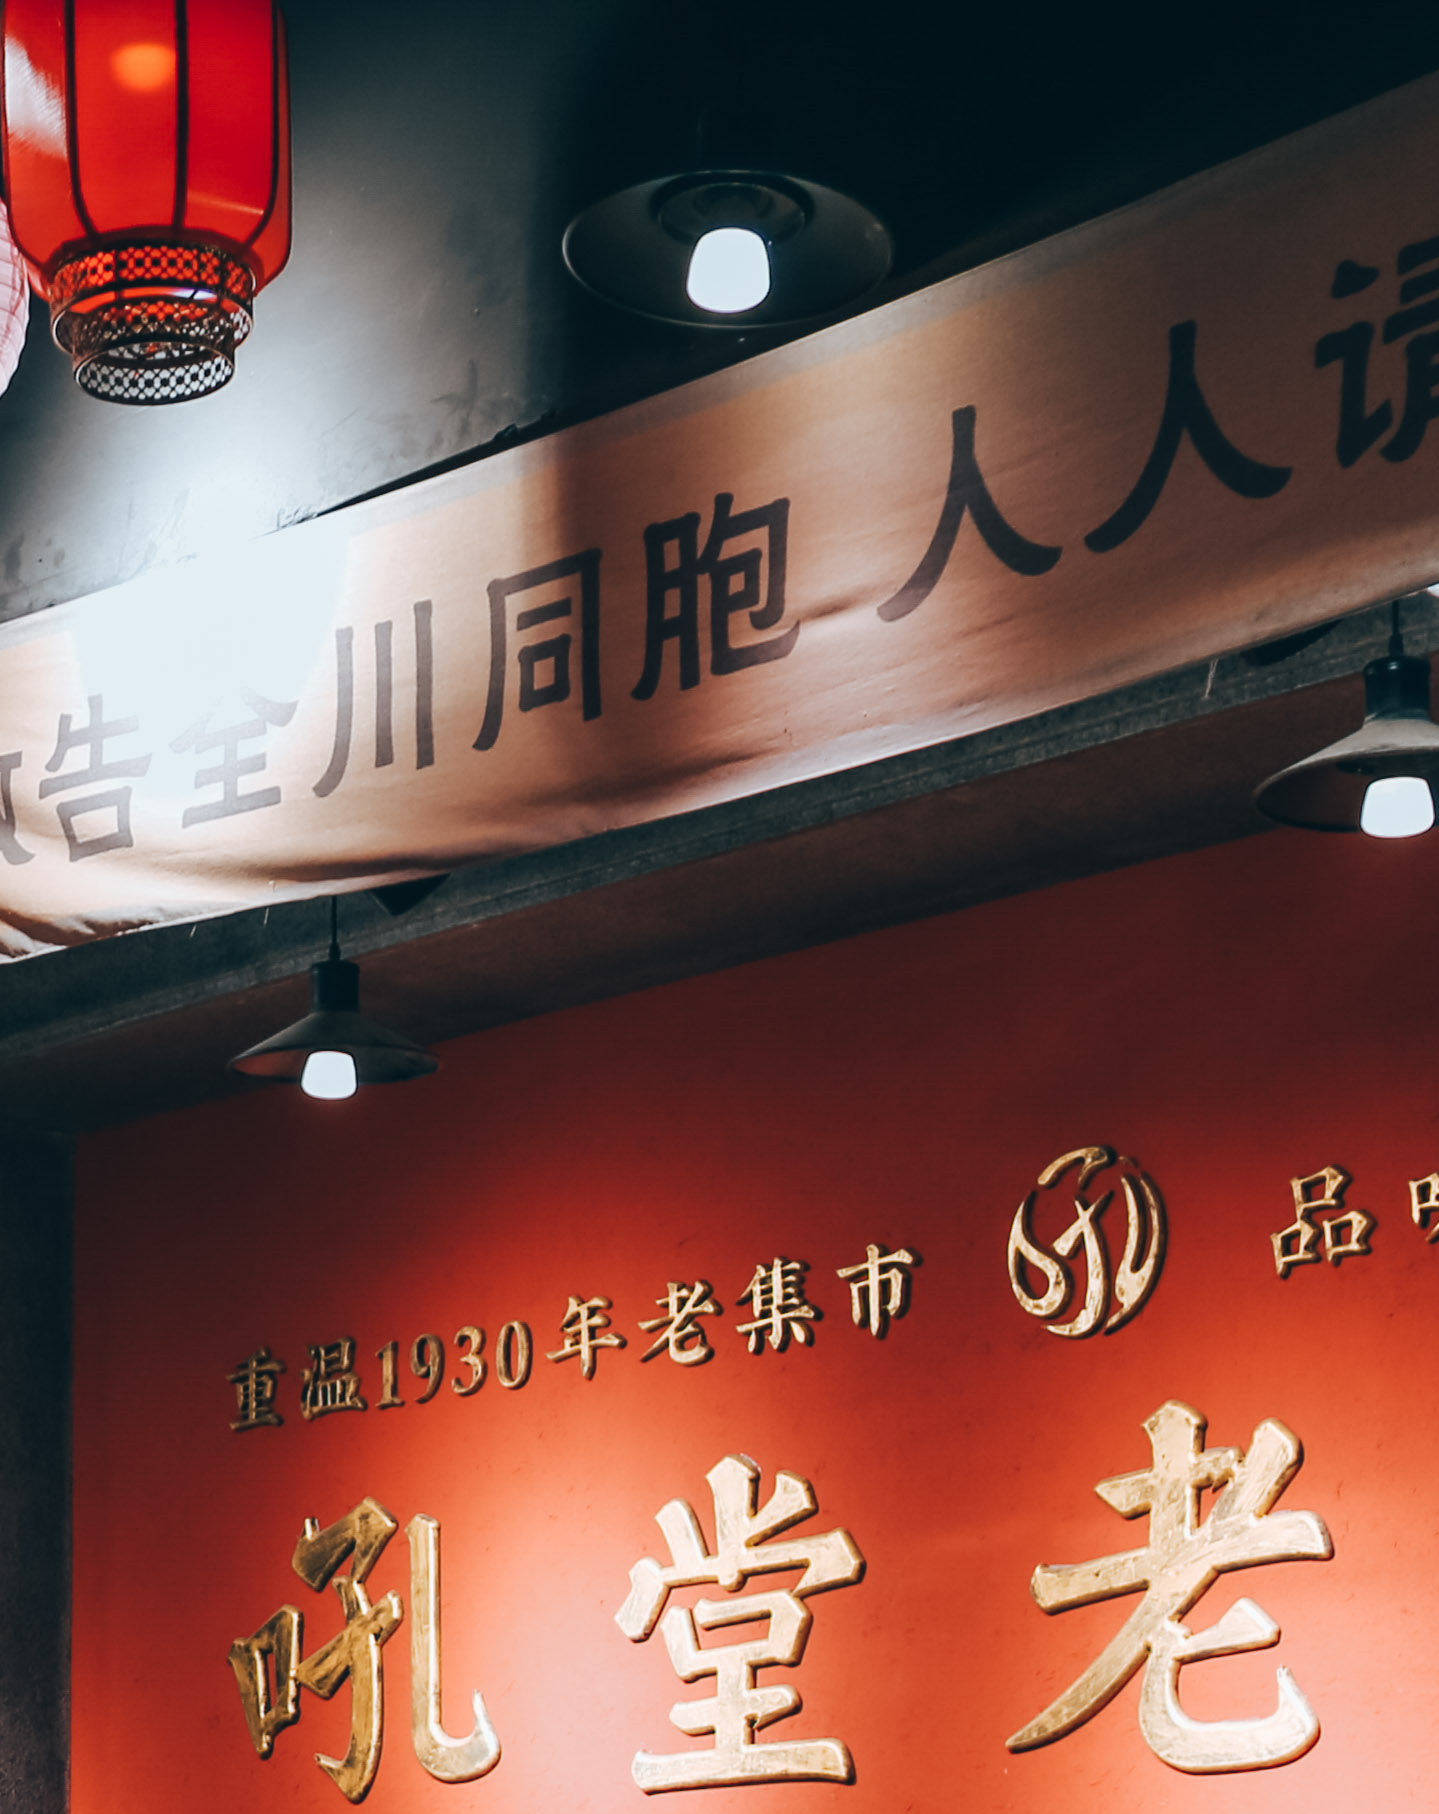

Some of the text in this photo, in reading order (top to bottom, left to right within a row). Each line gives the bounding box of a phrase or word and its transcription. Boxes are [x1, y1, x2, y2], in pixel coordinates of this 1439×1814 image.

[225, 1241, 923, 1434] 重温1930年老集市
